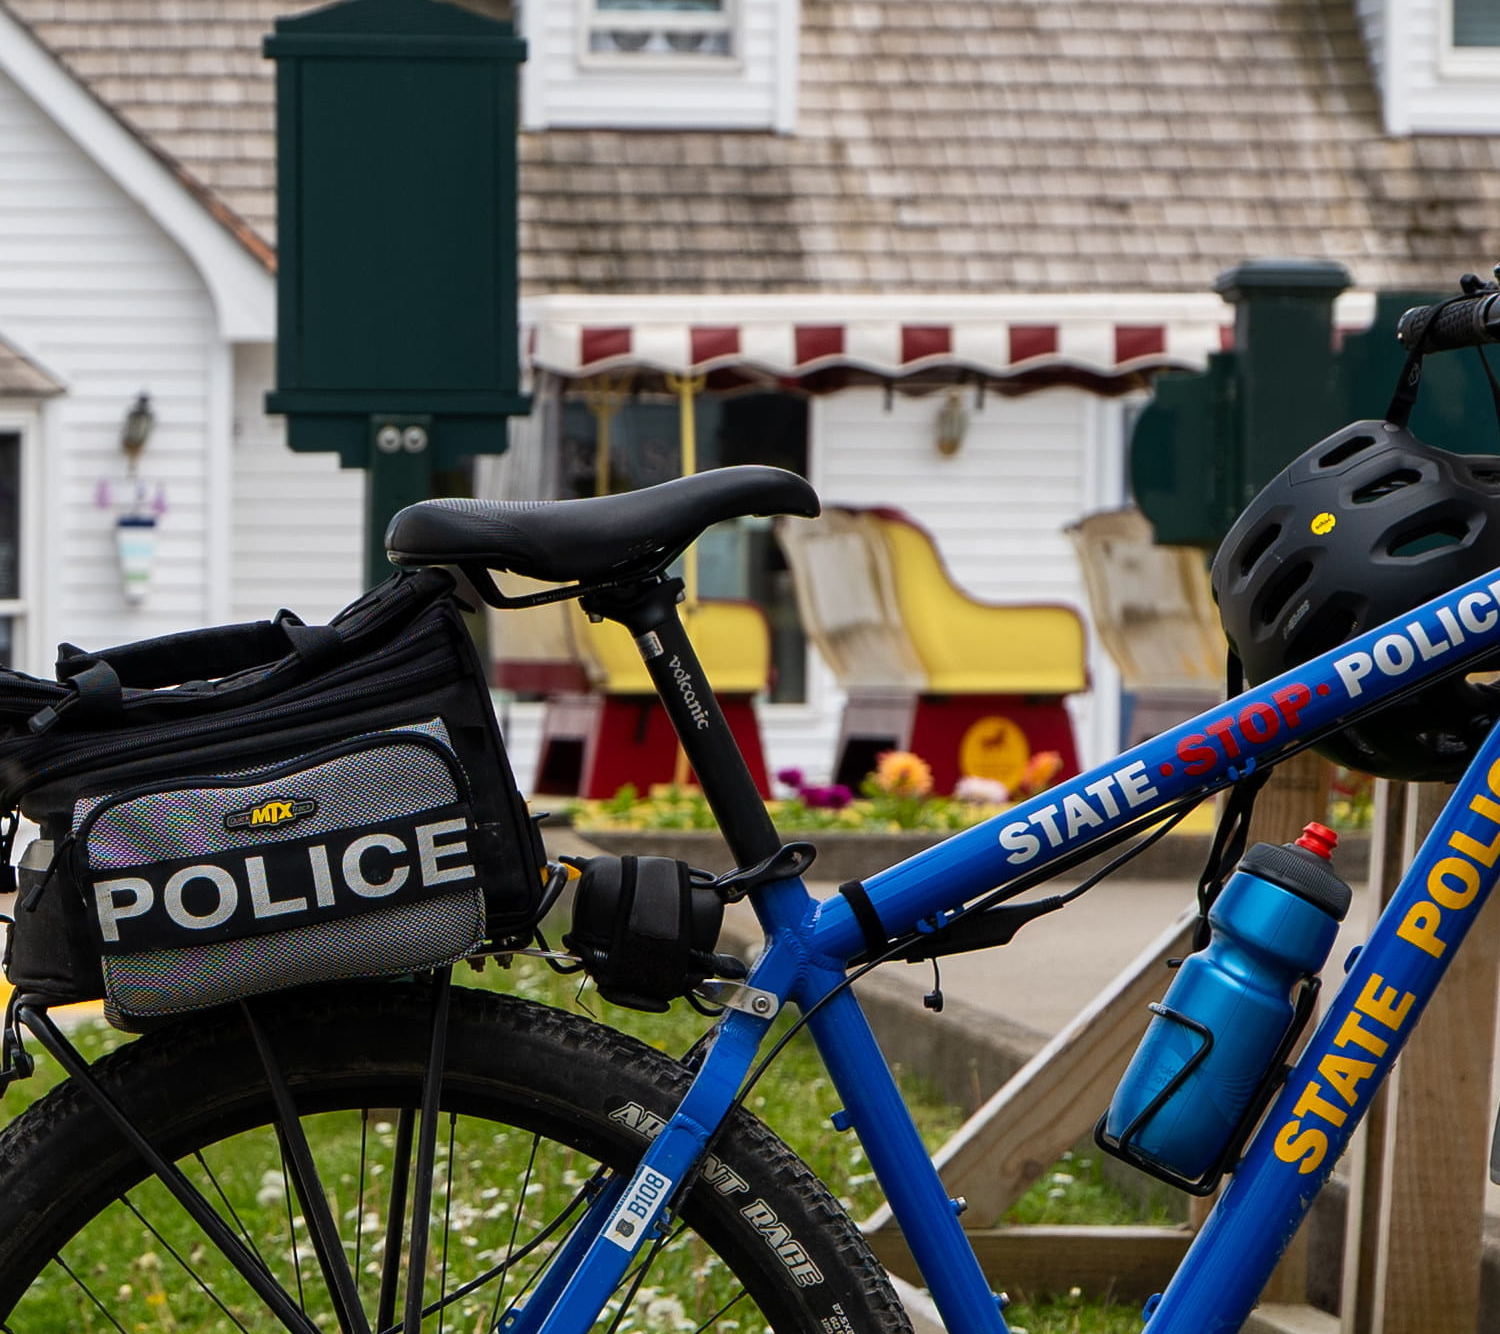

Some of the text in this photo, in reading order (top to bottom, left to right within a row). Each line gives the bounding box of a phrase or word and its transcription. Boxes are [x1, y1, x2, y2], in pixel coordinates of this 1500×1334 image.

[668, 654, 710, 730] volcanic
[251, 802, 294, 825] MTX
[998, 759, 1160, 866] STATE
[93, 817, 477, 943] POLICE
[1274, 973, 1416, 1175] STATE
[628, 1172, 665, 1221] B108
[740, 1198, 825, 1288] RACE
